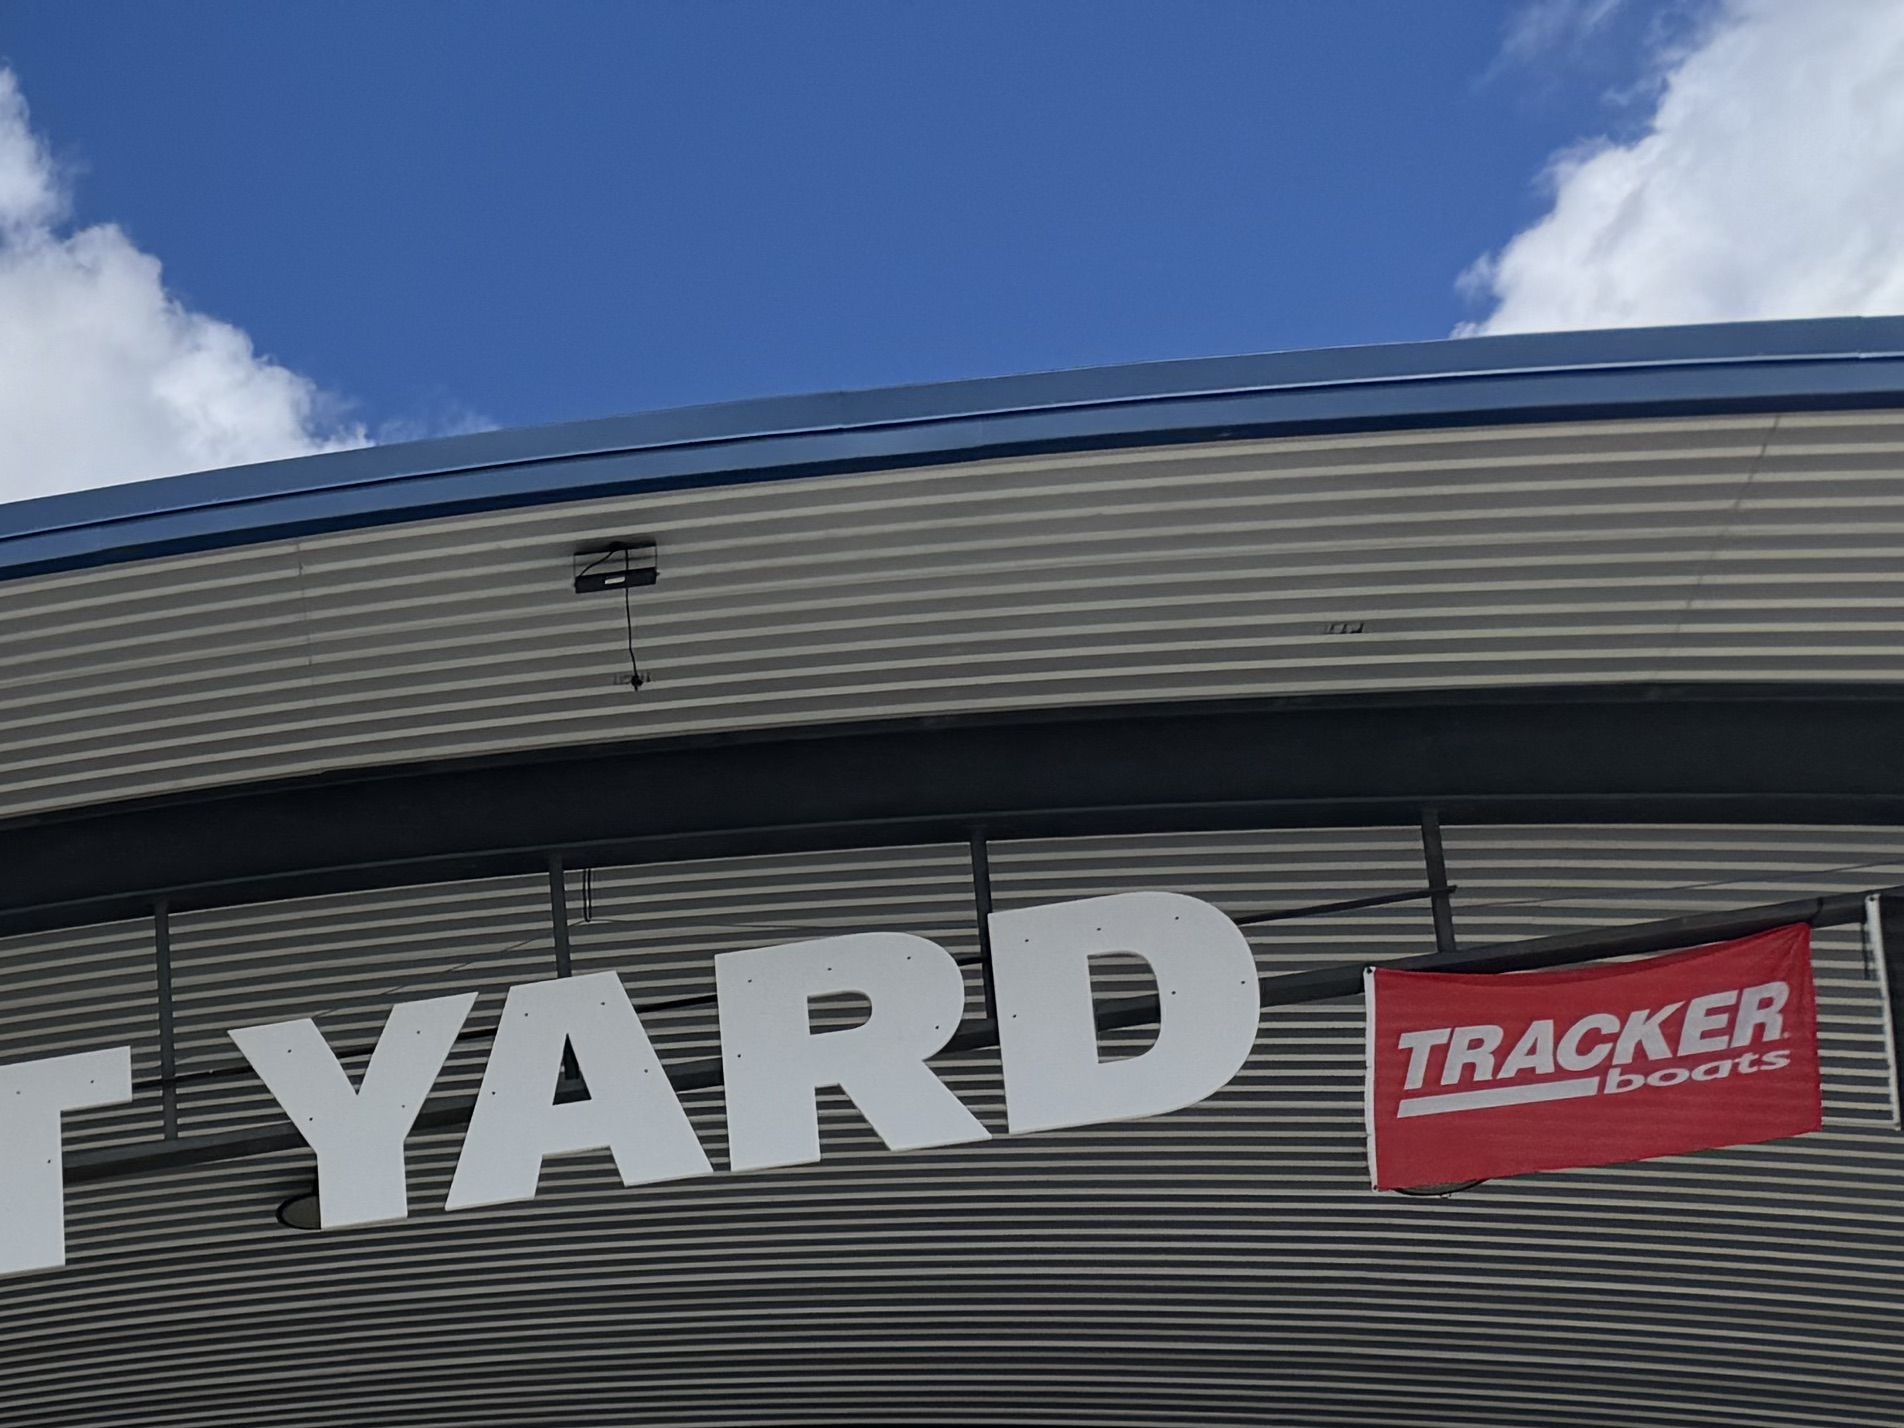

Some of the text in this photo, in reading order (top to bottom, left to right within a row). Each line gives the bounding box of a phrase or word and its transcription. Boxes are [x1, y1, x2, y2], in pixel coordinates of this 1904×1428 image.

[227, 890, 1261, 1230] YARD
[1397, 980, 1791, 1090] TRACKER
[1603, 1047, 1792, 1095] boats
